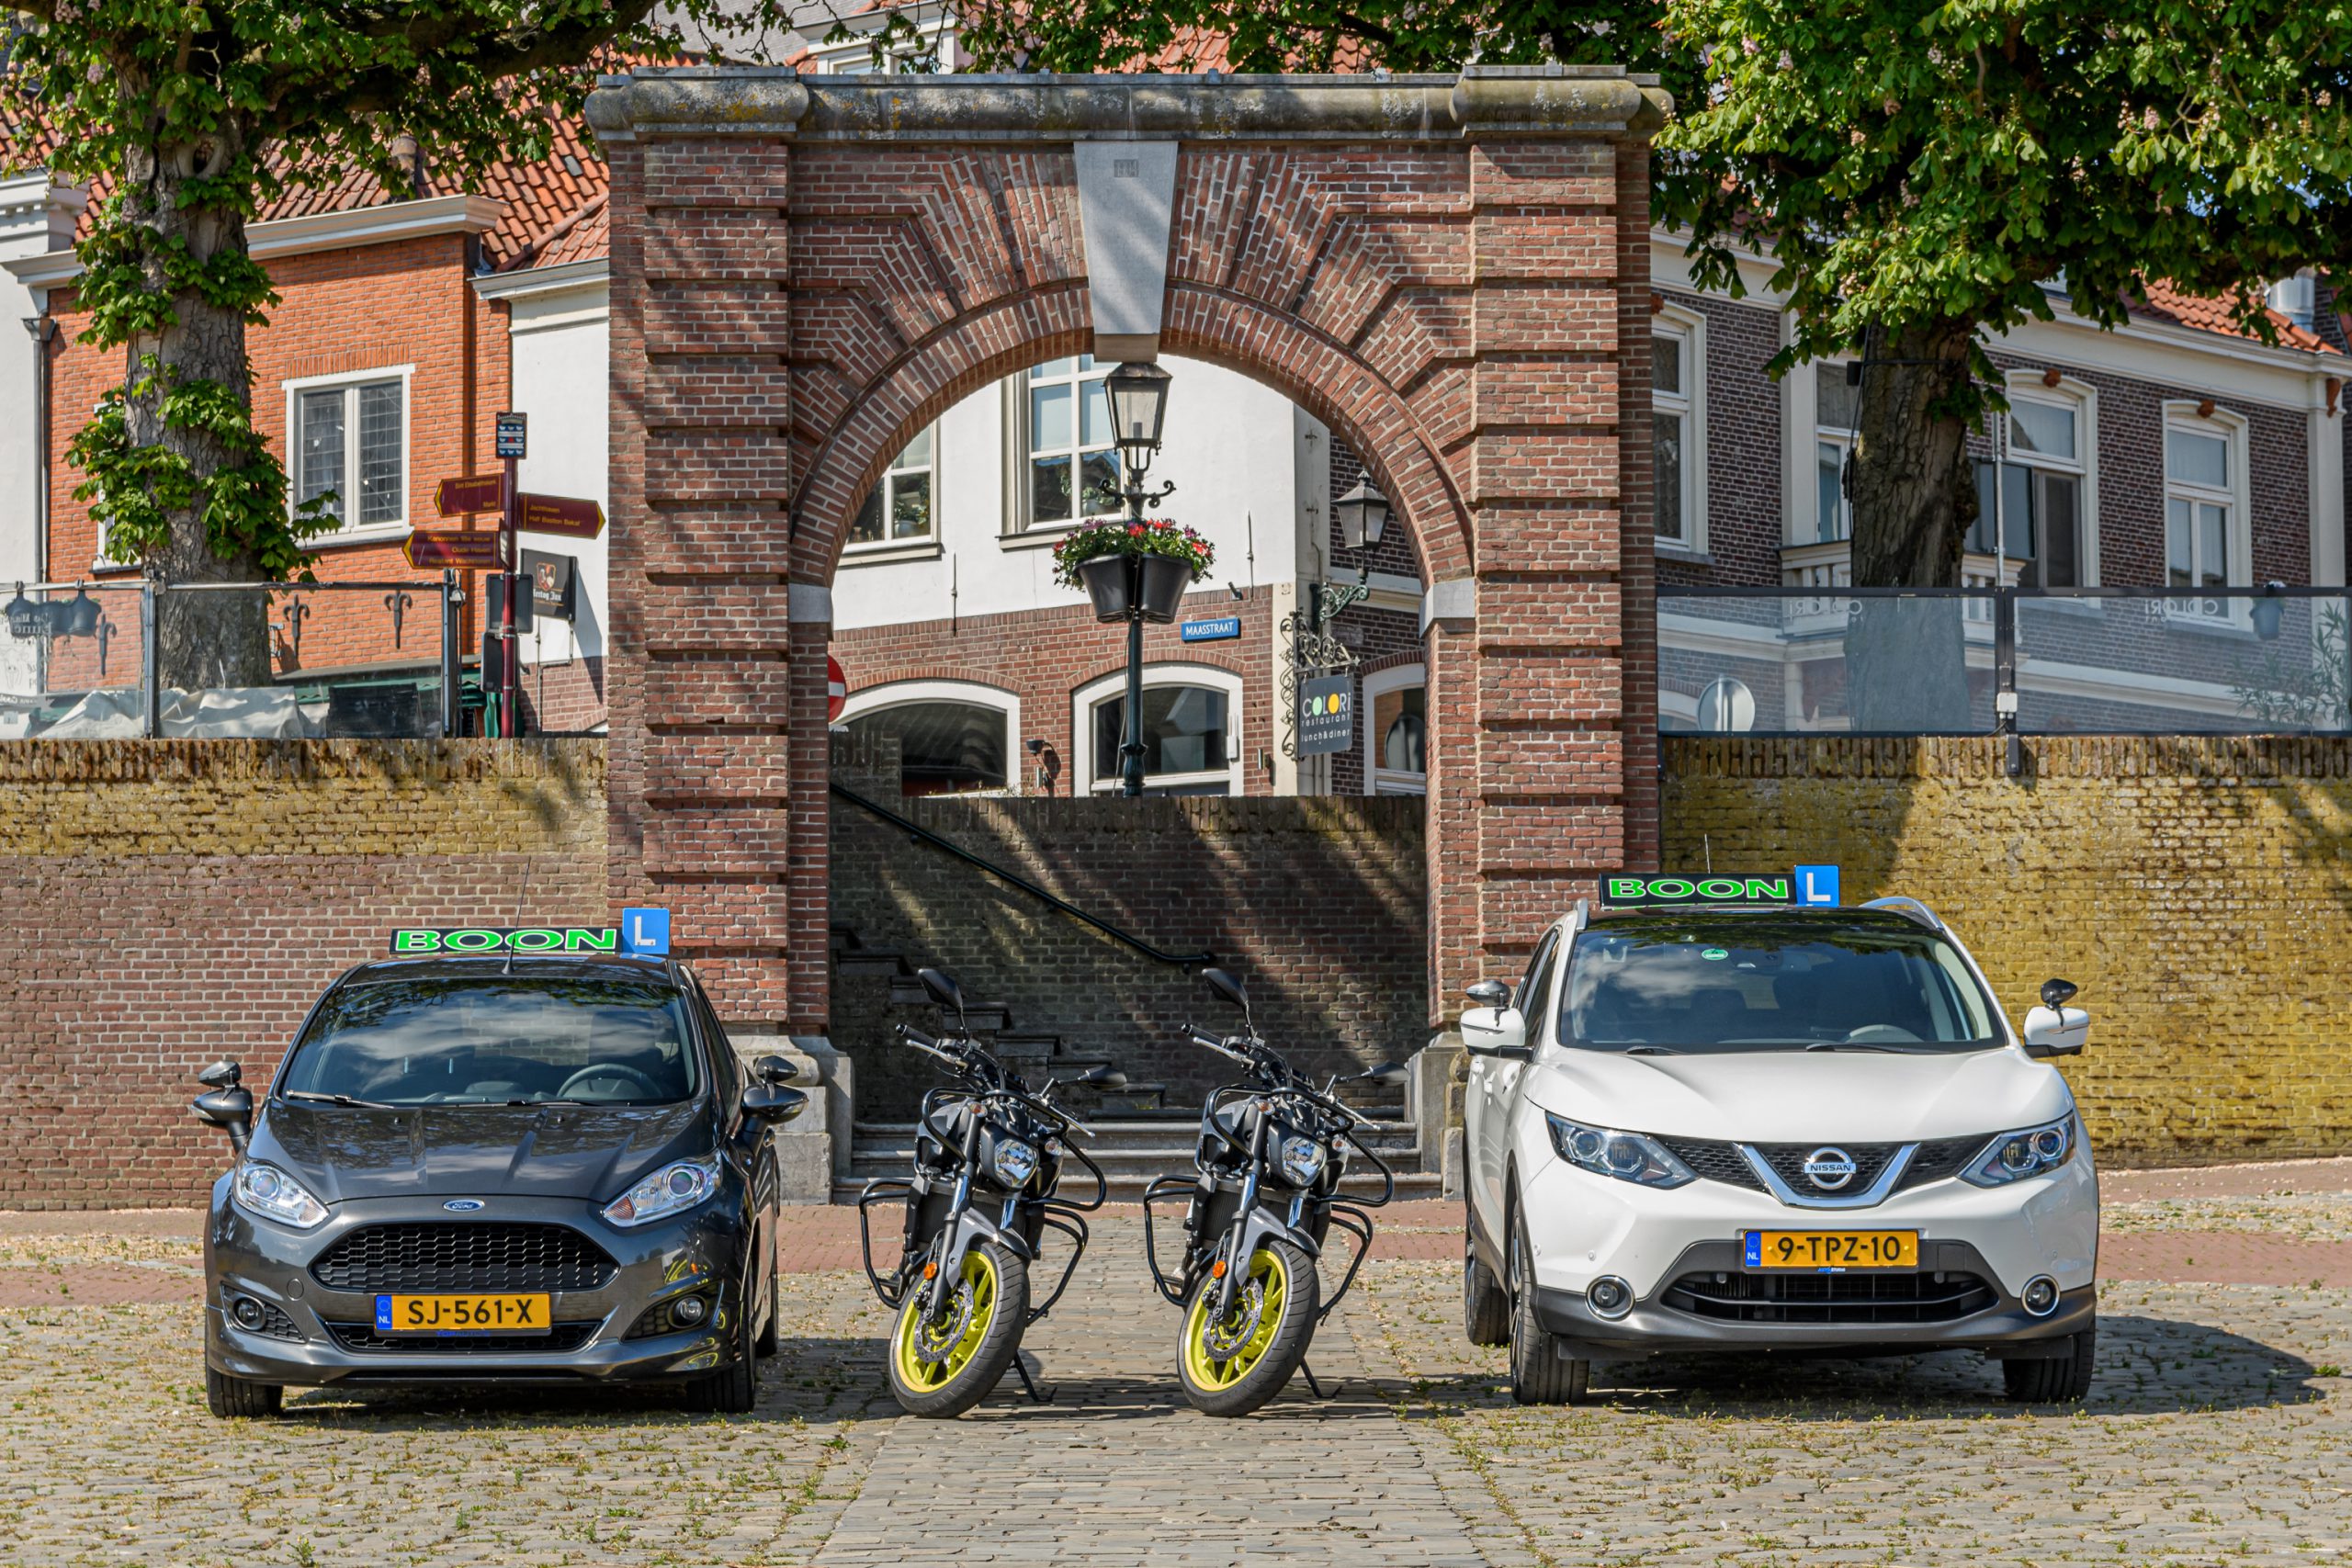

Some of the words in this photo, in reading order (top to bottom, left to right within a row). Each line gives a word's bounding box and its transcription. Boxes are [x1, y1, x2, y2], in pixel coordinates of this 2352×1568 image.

[1185, 622, 1234, 637] MAASSTRAAT
[1301, 712, 1351, 728] restaurant
[1301, 728, 1351, 743] lunch&diner
[1608, 878, 1790, 899] BOON
[1806, 872, 1831, 902] L
[396, 928, 617, 952] BOON
[634, 916, 656, 946] L
[1747, 1252, 1759, 1260] NL
[1777, 1235, 1901, 1262] 9-TPZ-10
[379, 1315, 390, 1325] NL
[407, 1299, 533, 1325] SJ-561-X
